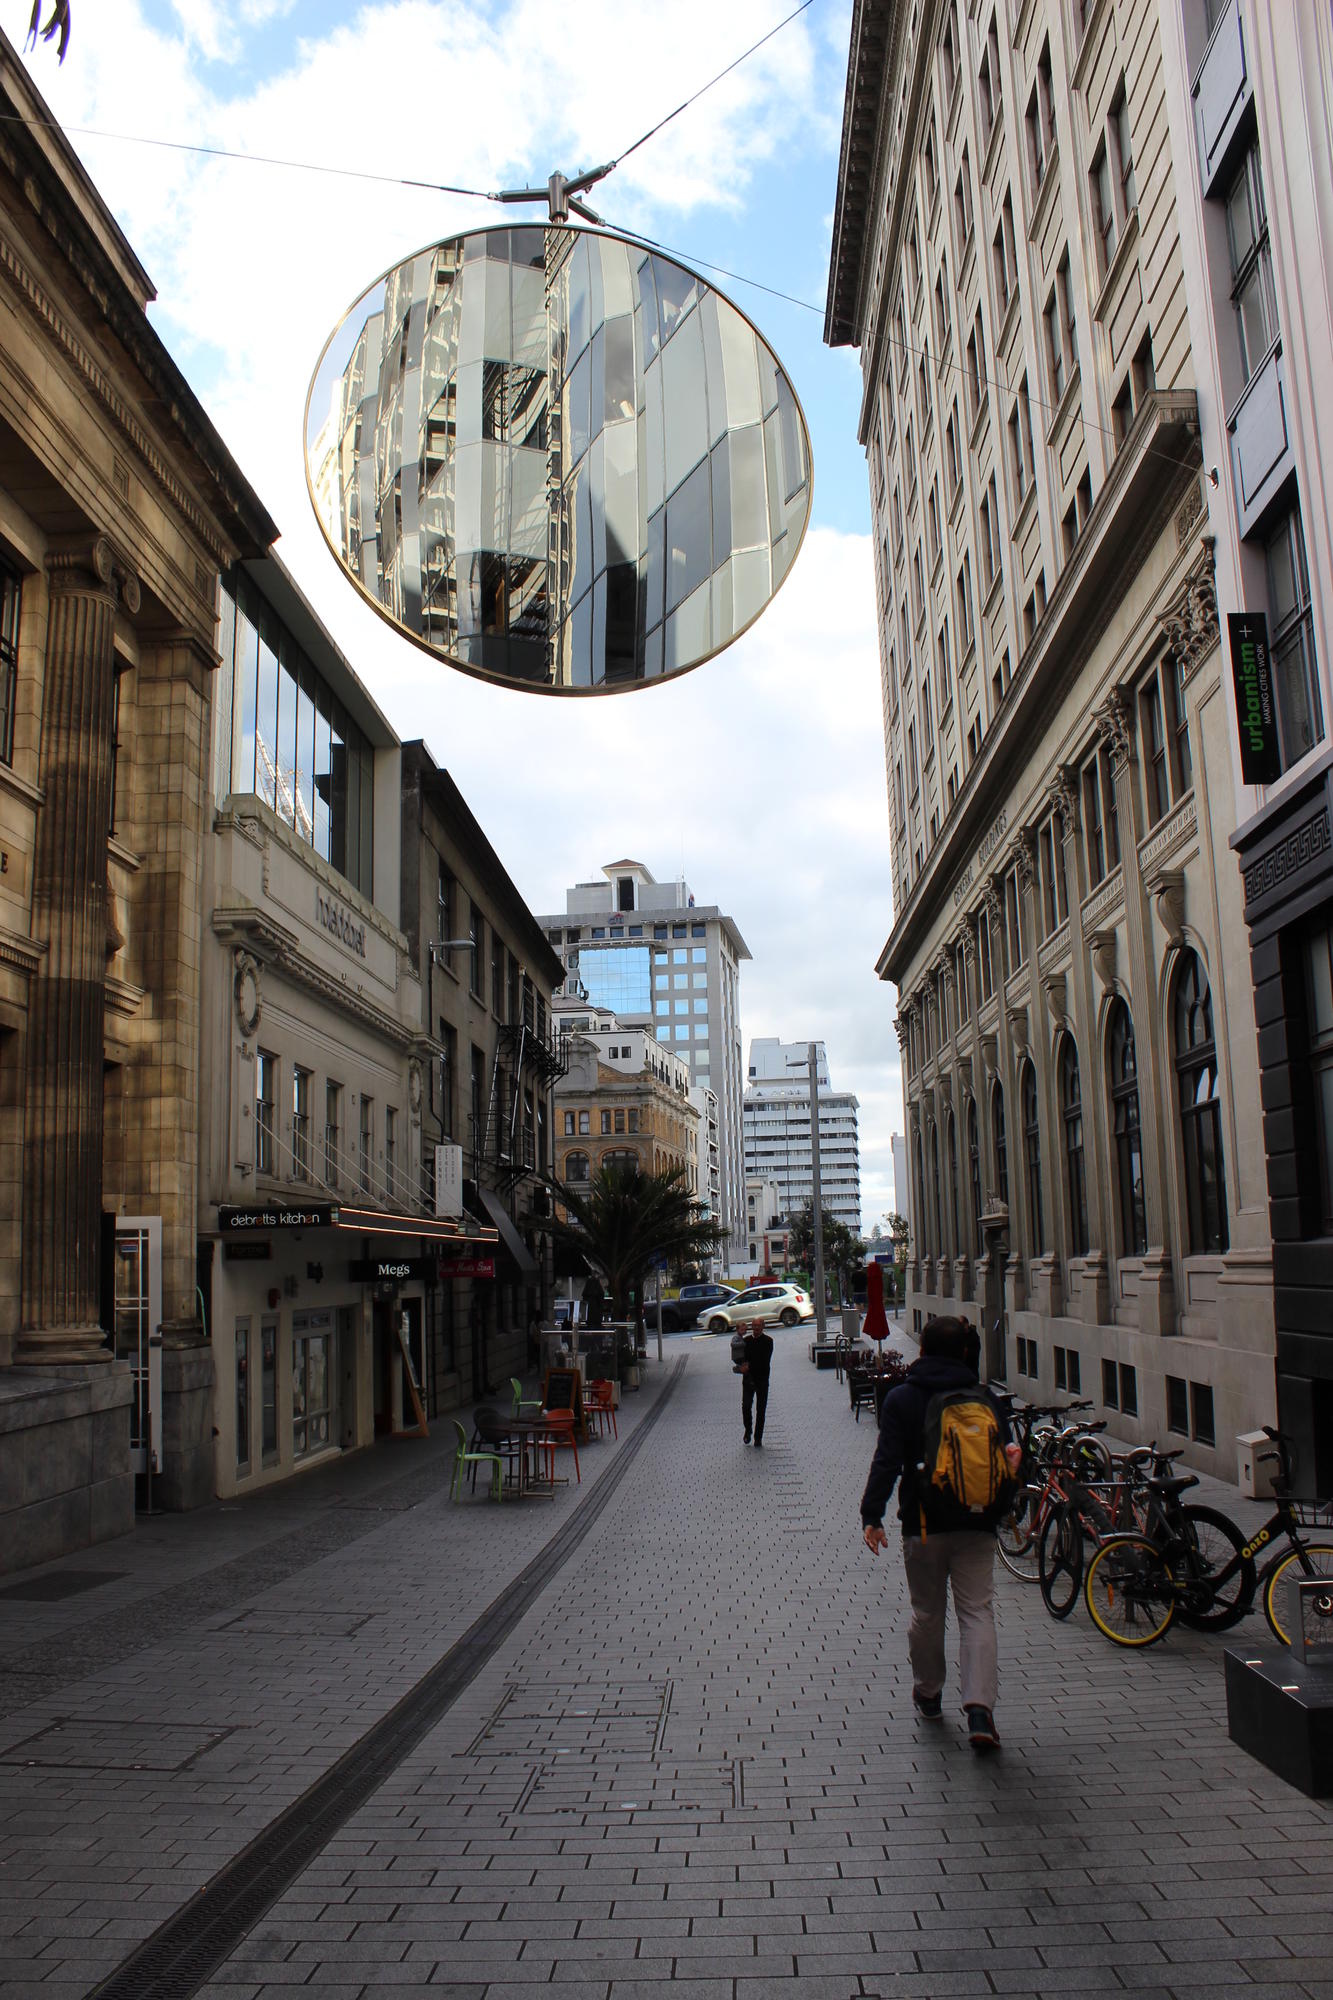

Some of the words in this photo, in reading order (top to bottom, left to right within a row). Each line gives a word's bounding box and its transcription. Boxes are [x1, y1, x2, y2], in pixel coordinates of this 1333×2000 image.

[1256, 643, 1265, 668] WORK
[1259, 669, 1268, 691] CITIES
[1261, 692, 1271, 724] MAKING
[230, 1214, 277, 1226] debretts
[280, 1212, 320, 1225] kitchen
